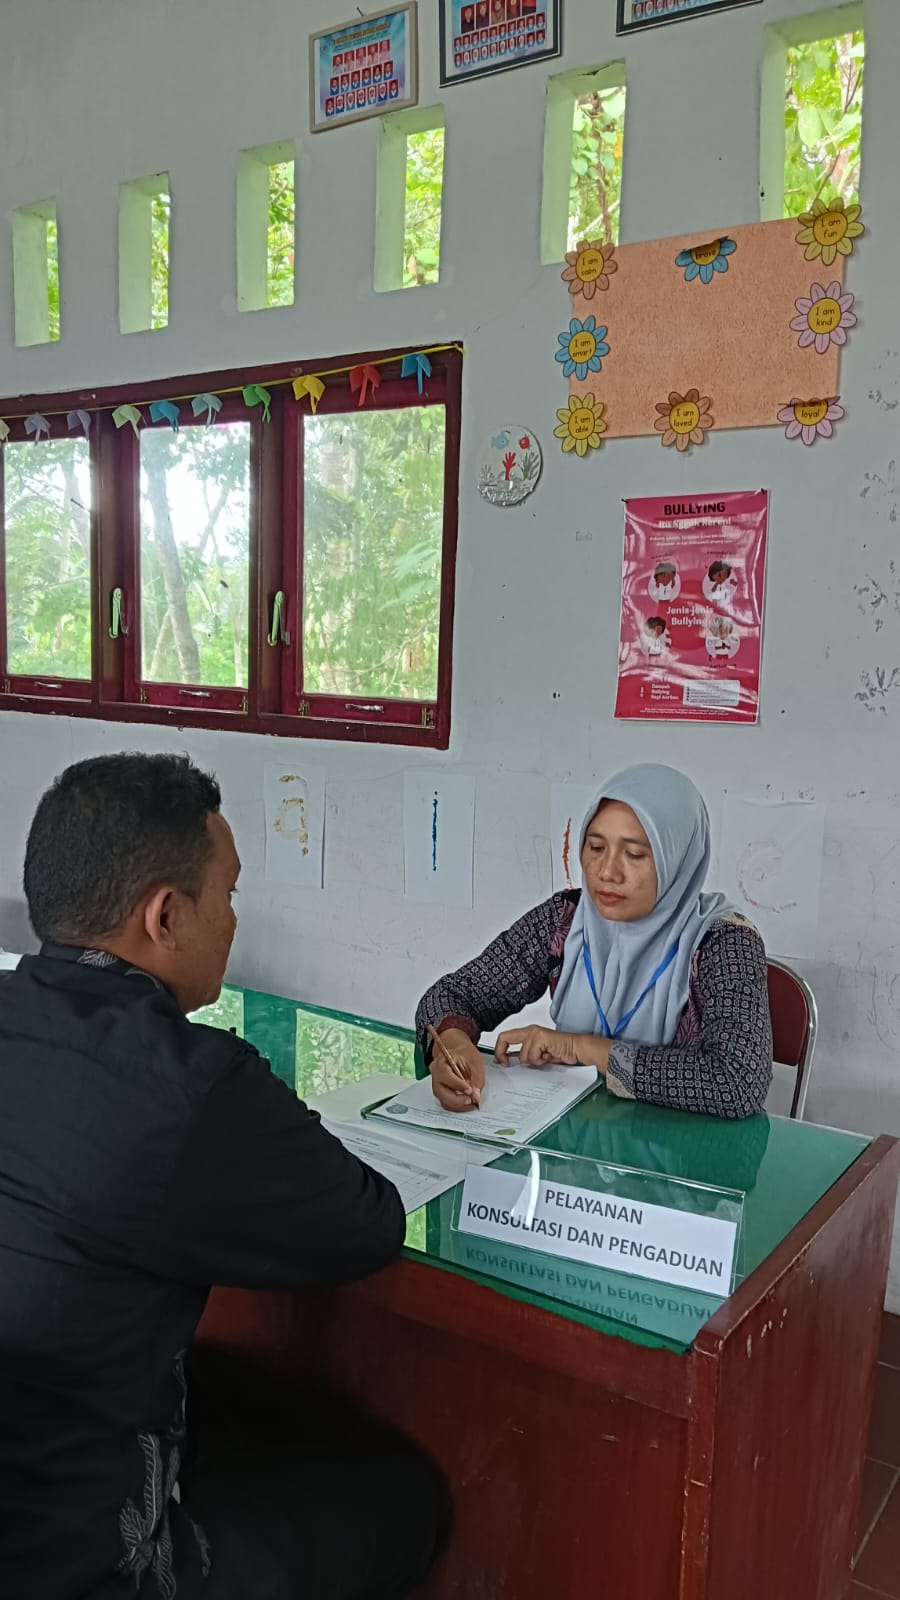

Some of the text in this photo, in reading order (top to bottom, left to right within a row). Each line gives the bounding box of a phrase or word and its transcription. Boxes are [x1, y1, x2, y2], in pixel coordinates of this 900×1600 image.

[823, 230, 838, 238] fun
[816, 317, 833, 326] kind
[801, 409, 820, 420] loyal
[673, 418, 693, 427] loved
[664, 501, 726, 516] BULLYING
[545, 1188, 643, 1225] PELAYANAN
[467, 1201, 723, 1278] KONSULTASI DAN PENGADUAN
